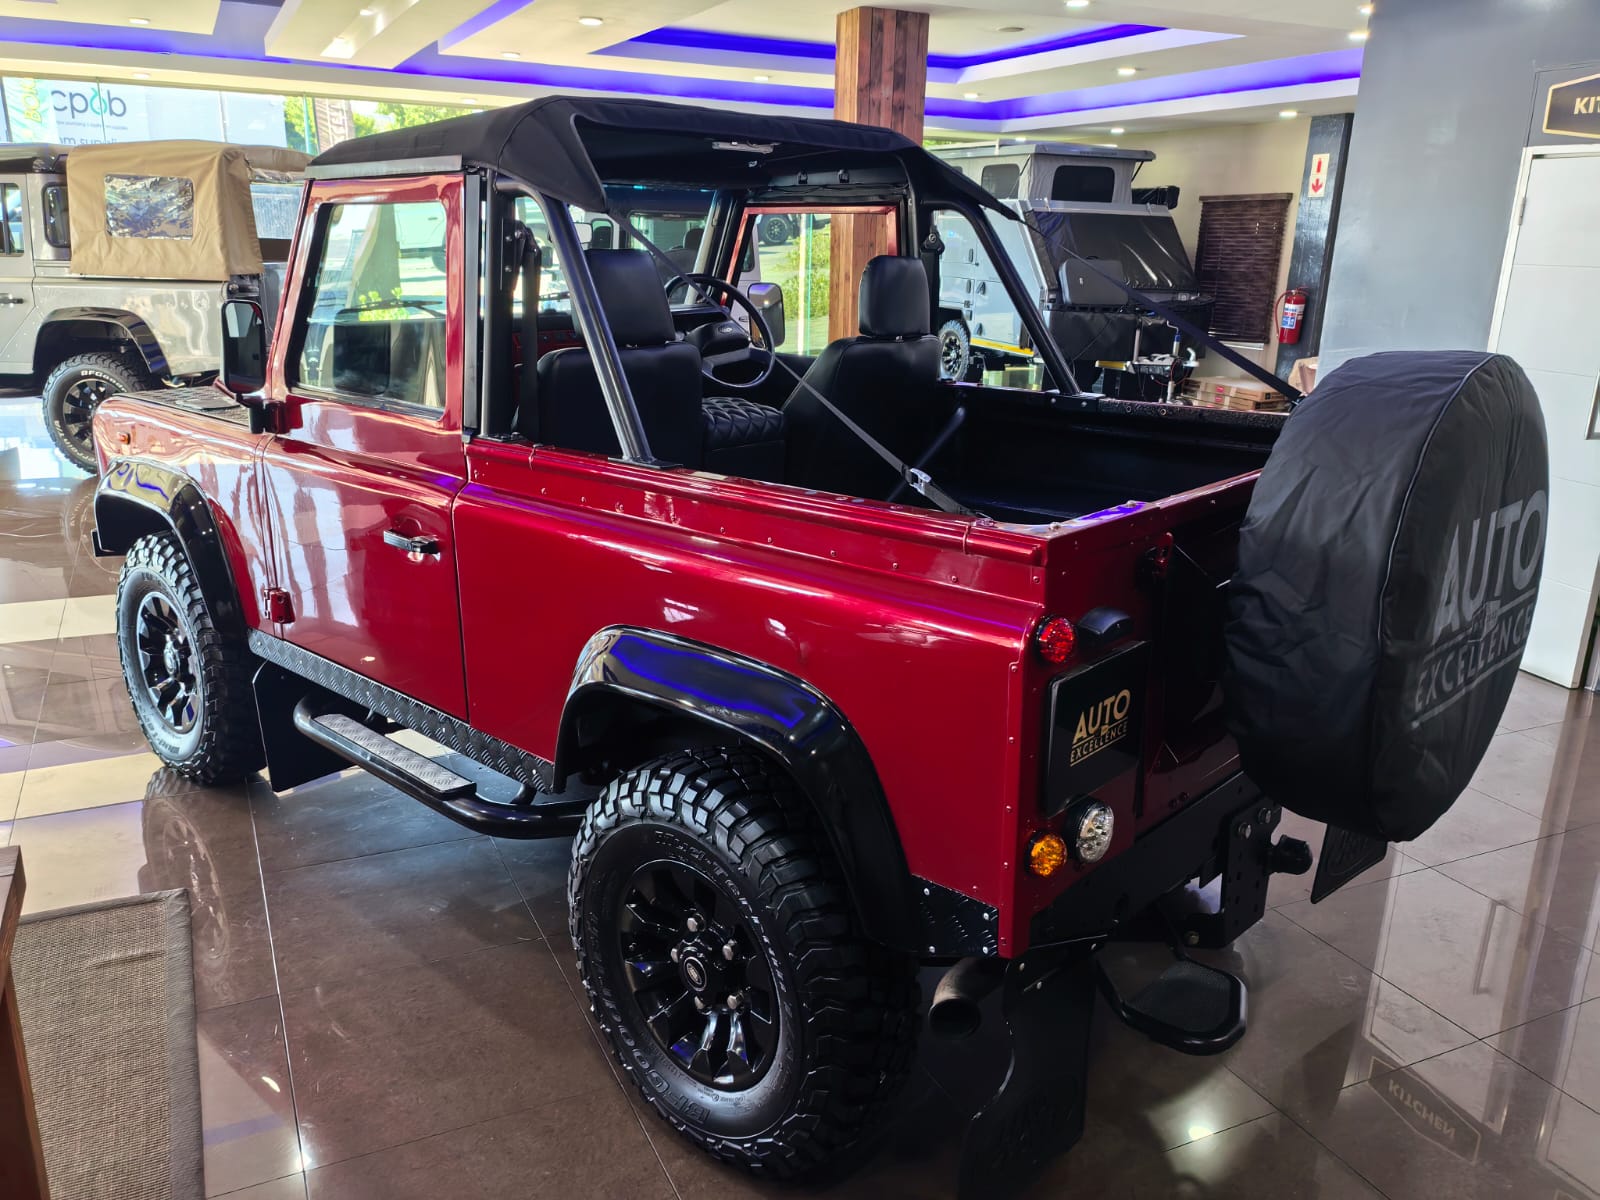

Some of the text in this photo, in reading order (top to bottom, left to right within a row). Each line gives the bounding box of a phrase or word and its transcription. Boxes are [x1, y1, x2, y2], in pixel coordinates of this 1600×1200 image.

[1432, 490, 1548, 646] AUTO
[1414, 603, 1533, 713] EXCELLENCE
[1070, 720, 1128, 763] EXCELLENCE
[1072, 689, 1131, 744] AUTO
